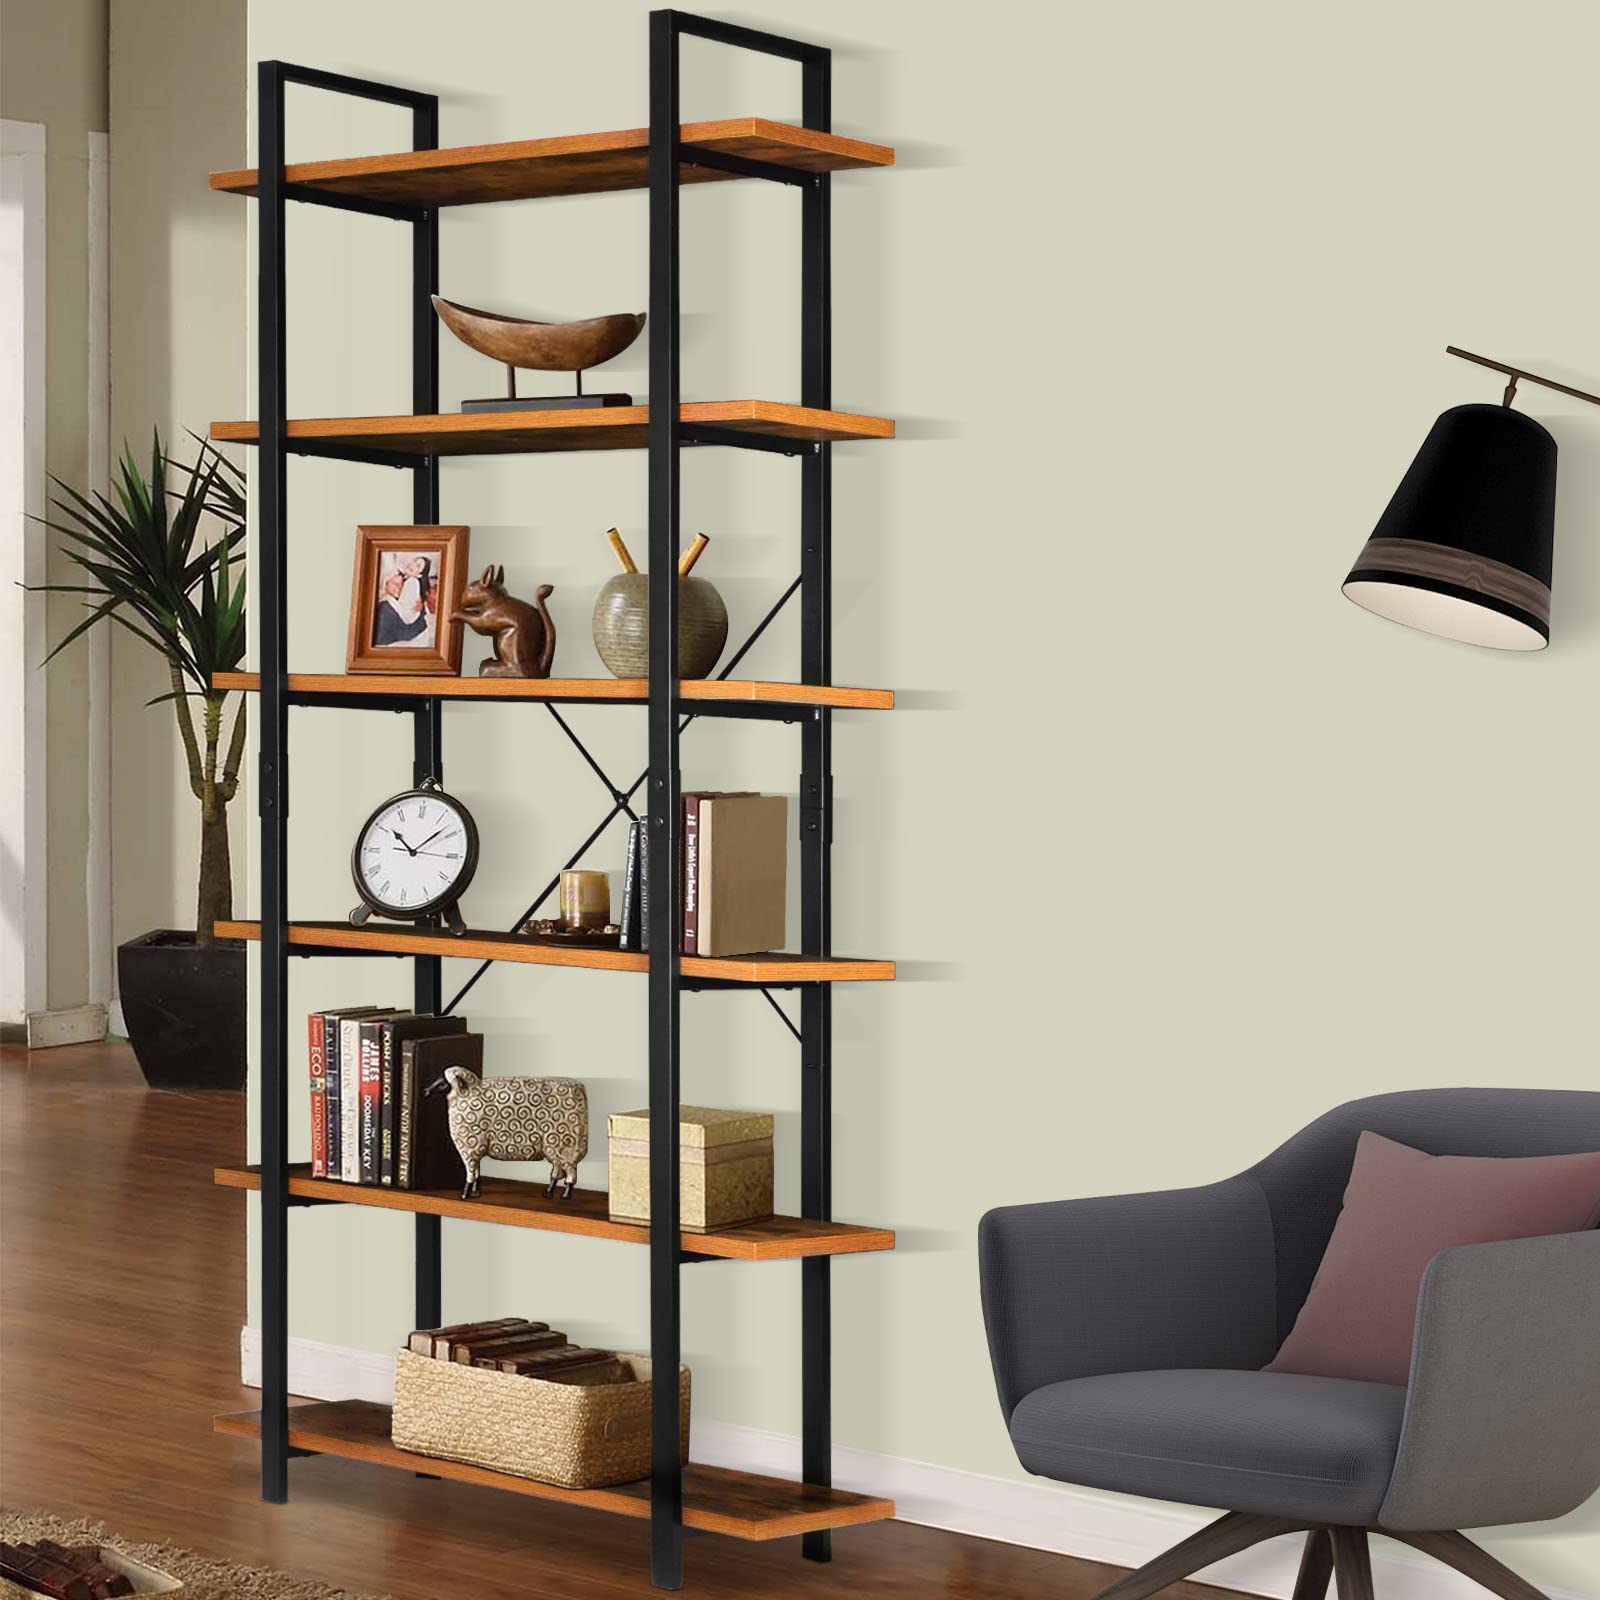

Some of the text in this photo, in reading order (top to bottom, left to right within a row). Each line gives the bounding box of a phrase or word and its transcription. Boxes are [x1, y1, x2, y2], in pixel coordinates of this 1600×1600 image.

[326, 1026, 335, 1065] PAUL
[383, 1030, 392, 1060] POSH
[311, 1047, 322, 1075] ECO
[362, 1039, 370, 1083] ROLLINS
[370, 1042, 380, 1081] JAMES
[363, 1095, 372, 1169] DOOMSDAY KEY
[400, 1108, 409, 1133] RUN
[400, 1136, 409, 1162] JANE
[399, 1162, 408, 1182] SEE
